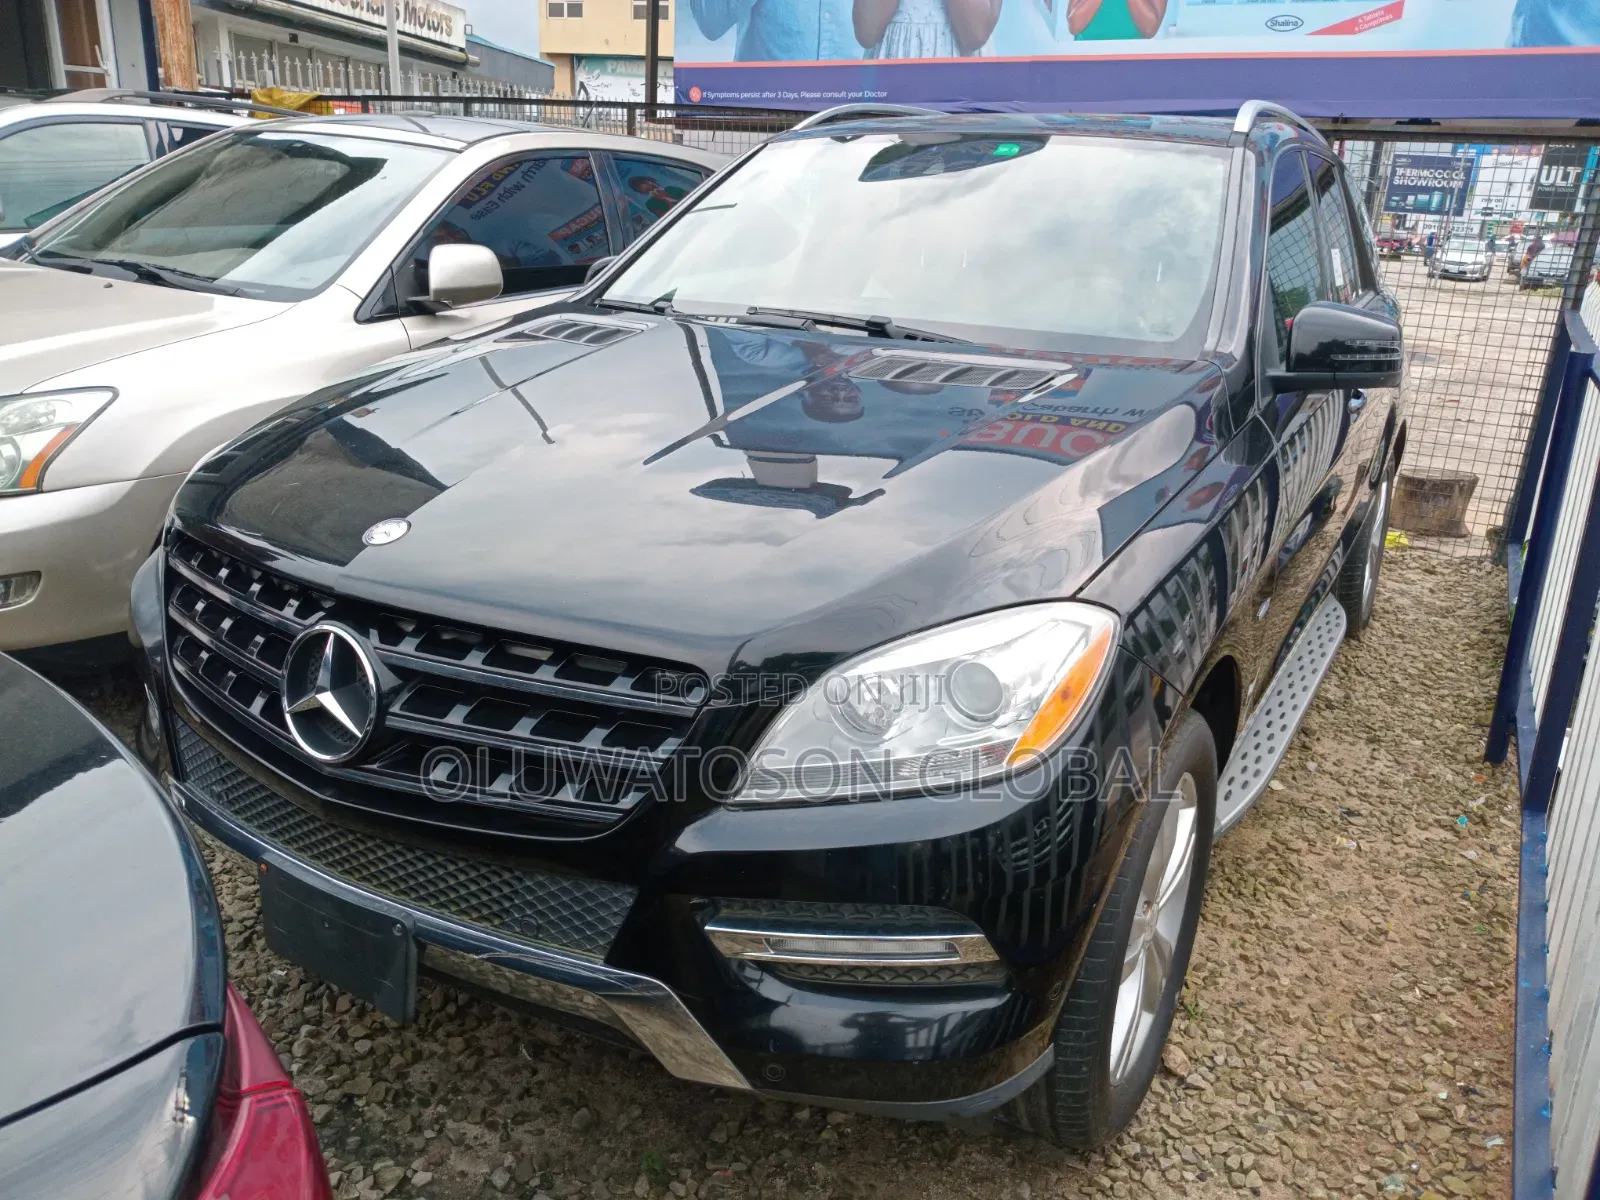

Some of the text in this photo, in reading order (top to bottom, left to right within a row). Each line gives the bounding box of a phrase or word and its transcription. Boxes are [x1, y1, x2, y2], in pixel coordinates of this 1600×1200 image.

[403, 0, 453, 37] Motors
[1270, 19, 1299, 27] Shalina
[707, 91, 740, 100] Symptoms
[741, 91, 761, 100] persist
[783, 91, 799, 99] Days,
[847, 91, 863, 99] your
[864, 90, 887, 98] Doctor
[1540, 165, 1581, 187] ULT
